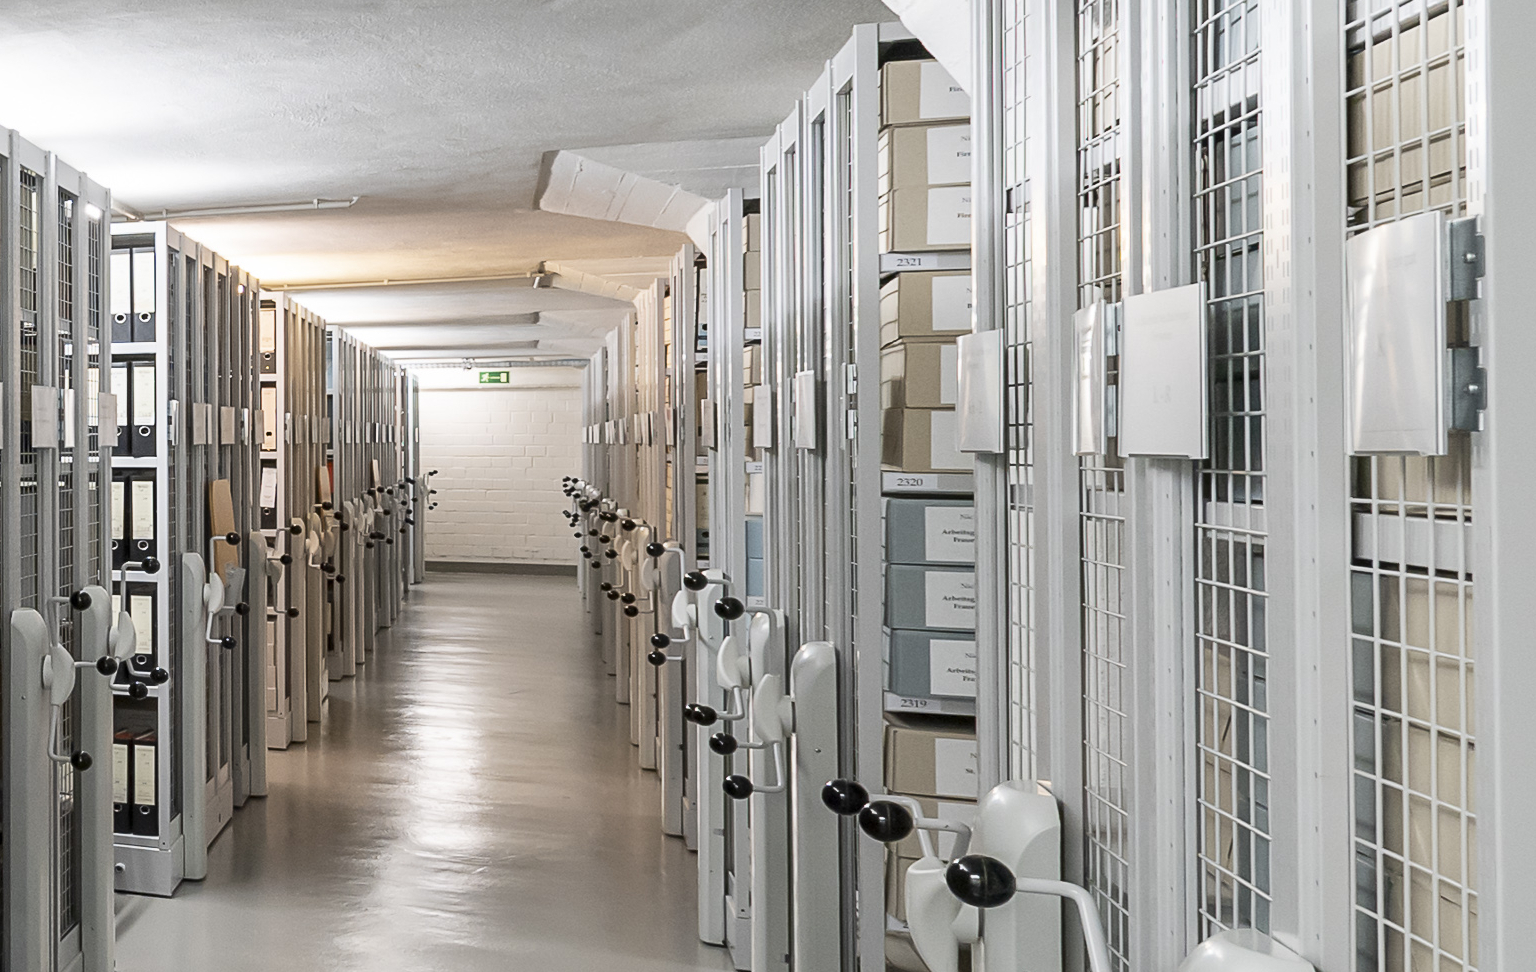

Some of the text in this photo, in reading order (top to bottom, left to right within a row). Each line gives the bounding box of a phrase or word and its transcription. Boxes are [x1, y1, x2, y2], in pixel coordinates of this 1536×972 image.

[897, 257, 922, 267] 2321
[897, 477, 923, 487] 2320
[901, 698, 927, 709] 2319
